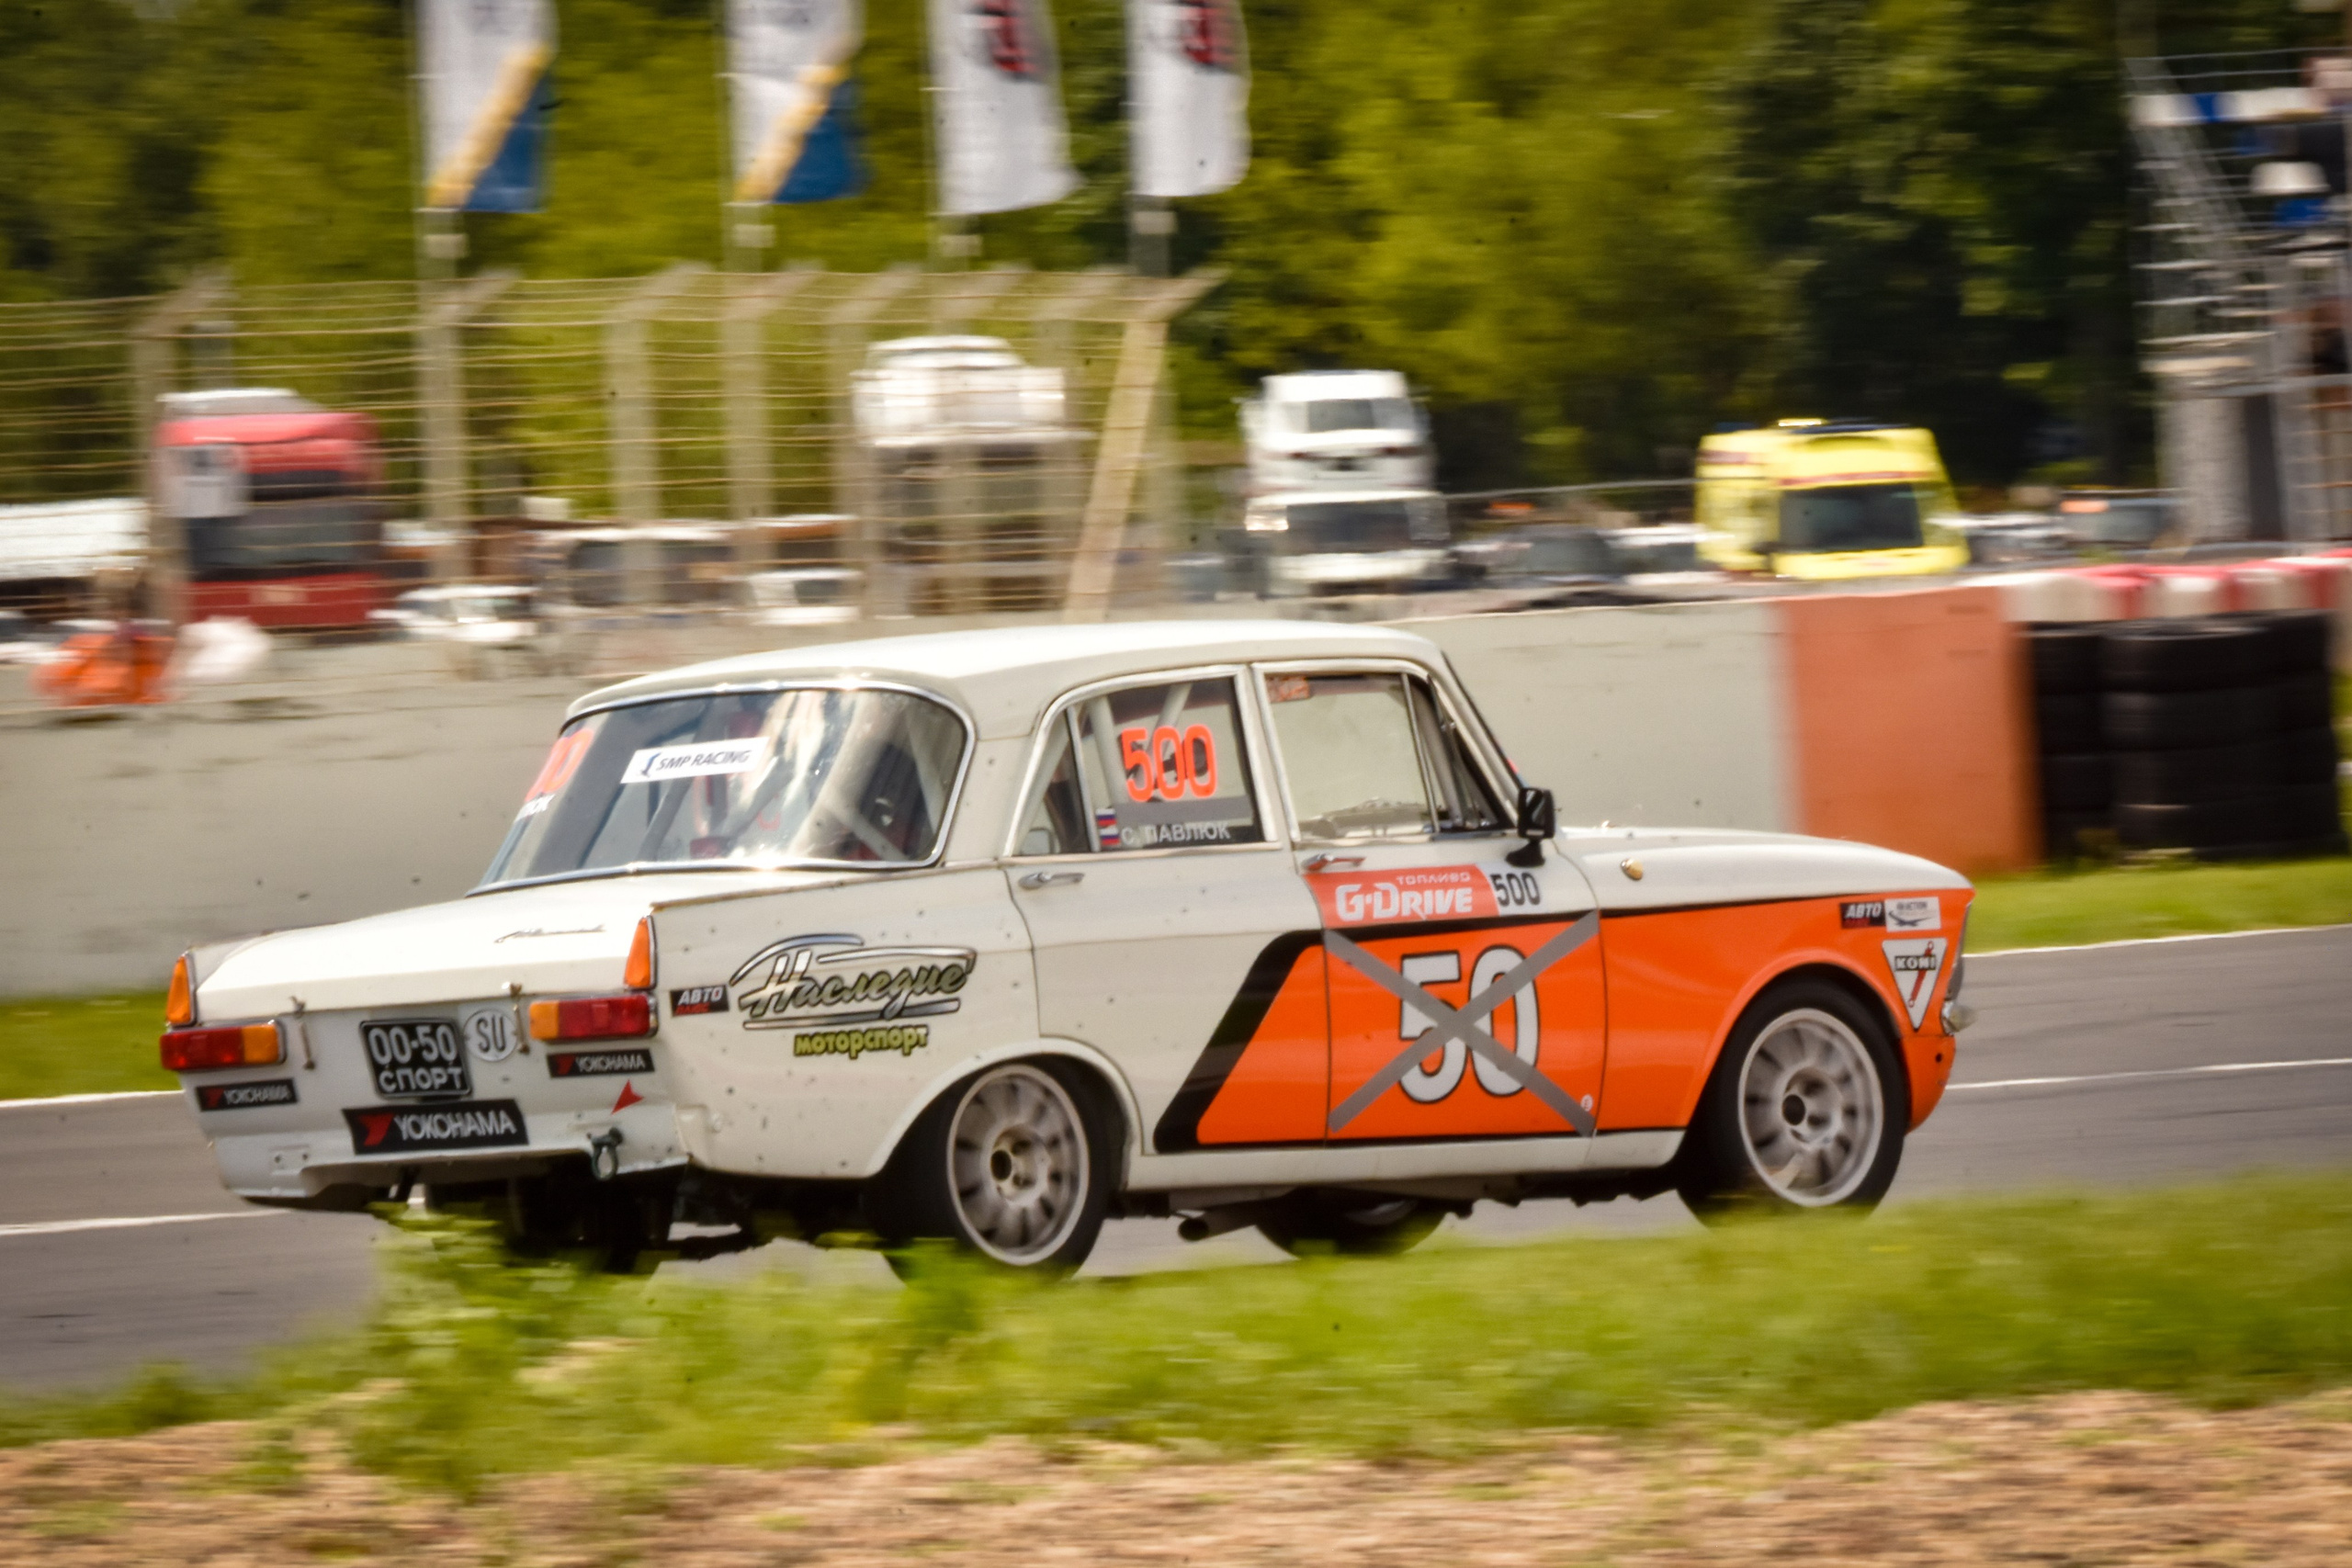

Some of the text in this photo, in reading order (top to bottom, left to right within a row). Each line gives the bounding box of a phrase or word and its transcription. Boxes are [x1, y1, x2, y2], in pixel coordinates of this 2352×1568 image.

[1121, 724, 1218, 803] 500
[1489, 873, 1541, 907] 500
[1896, 956, 1936, 969] KONI
[677, 987, 724, 1005] АВТО
[475, 1014, 506, 1054] SU
[1398, 944, 1540, 1104] 50
[379, 1066, 463, 1093] СПОРТ
[393, 1110, 517, 1141] YOKOHAMA
